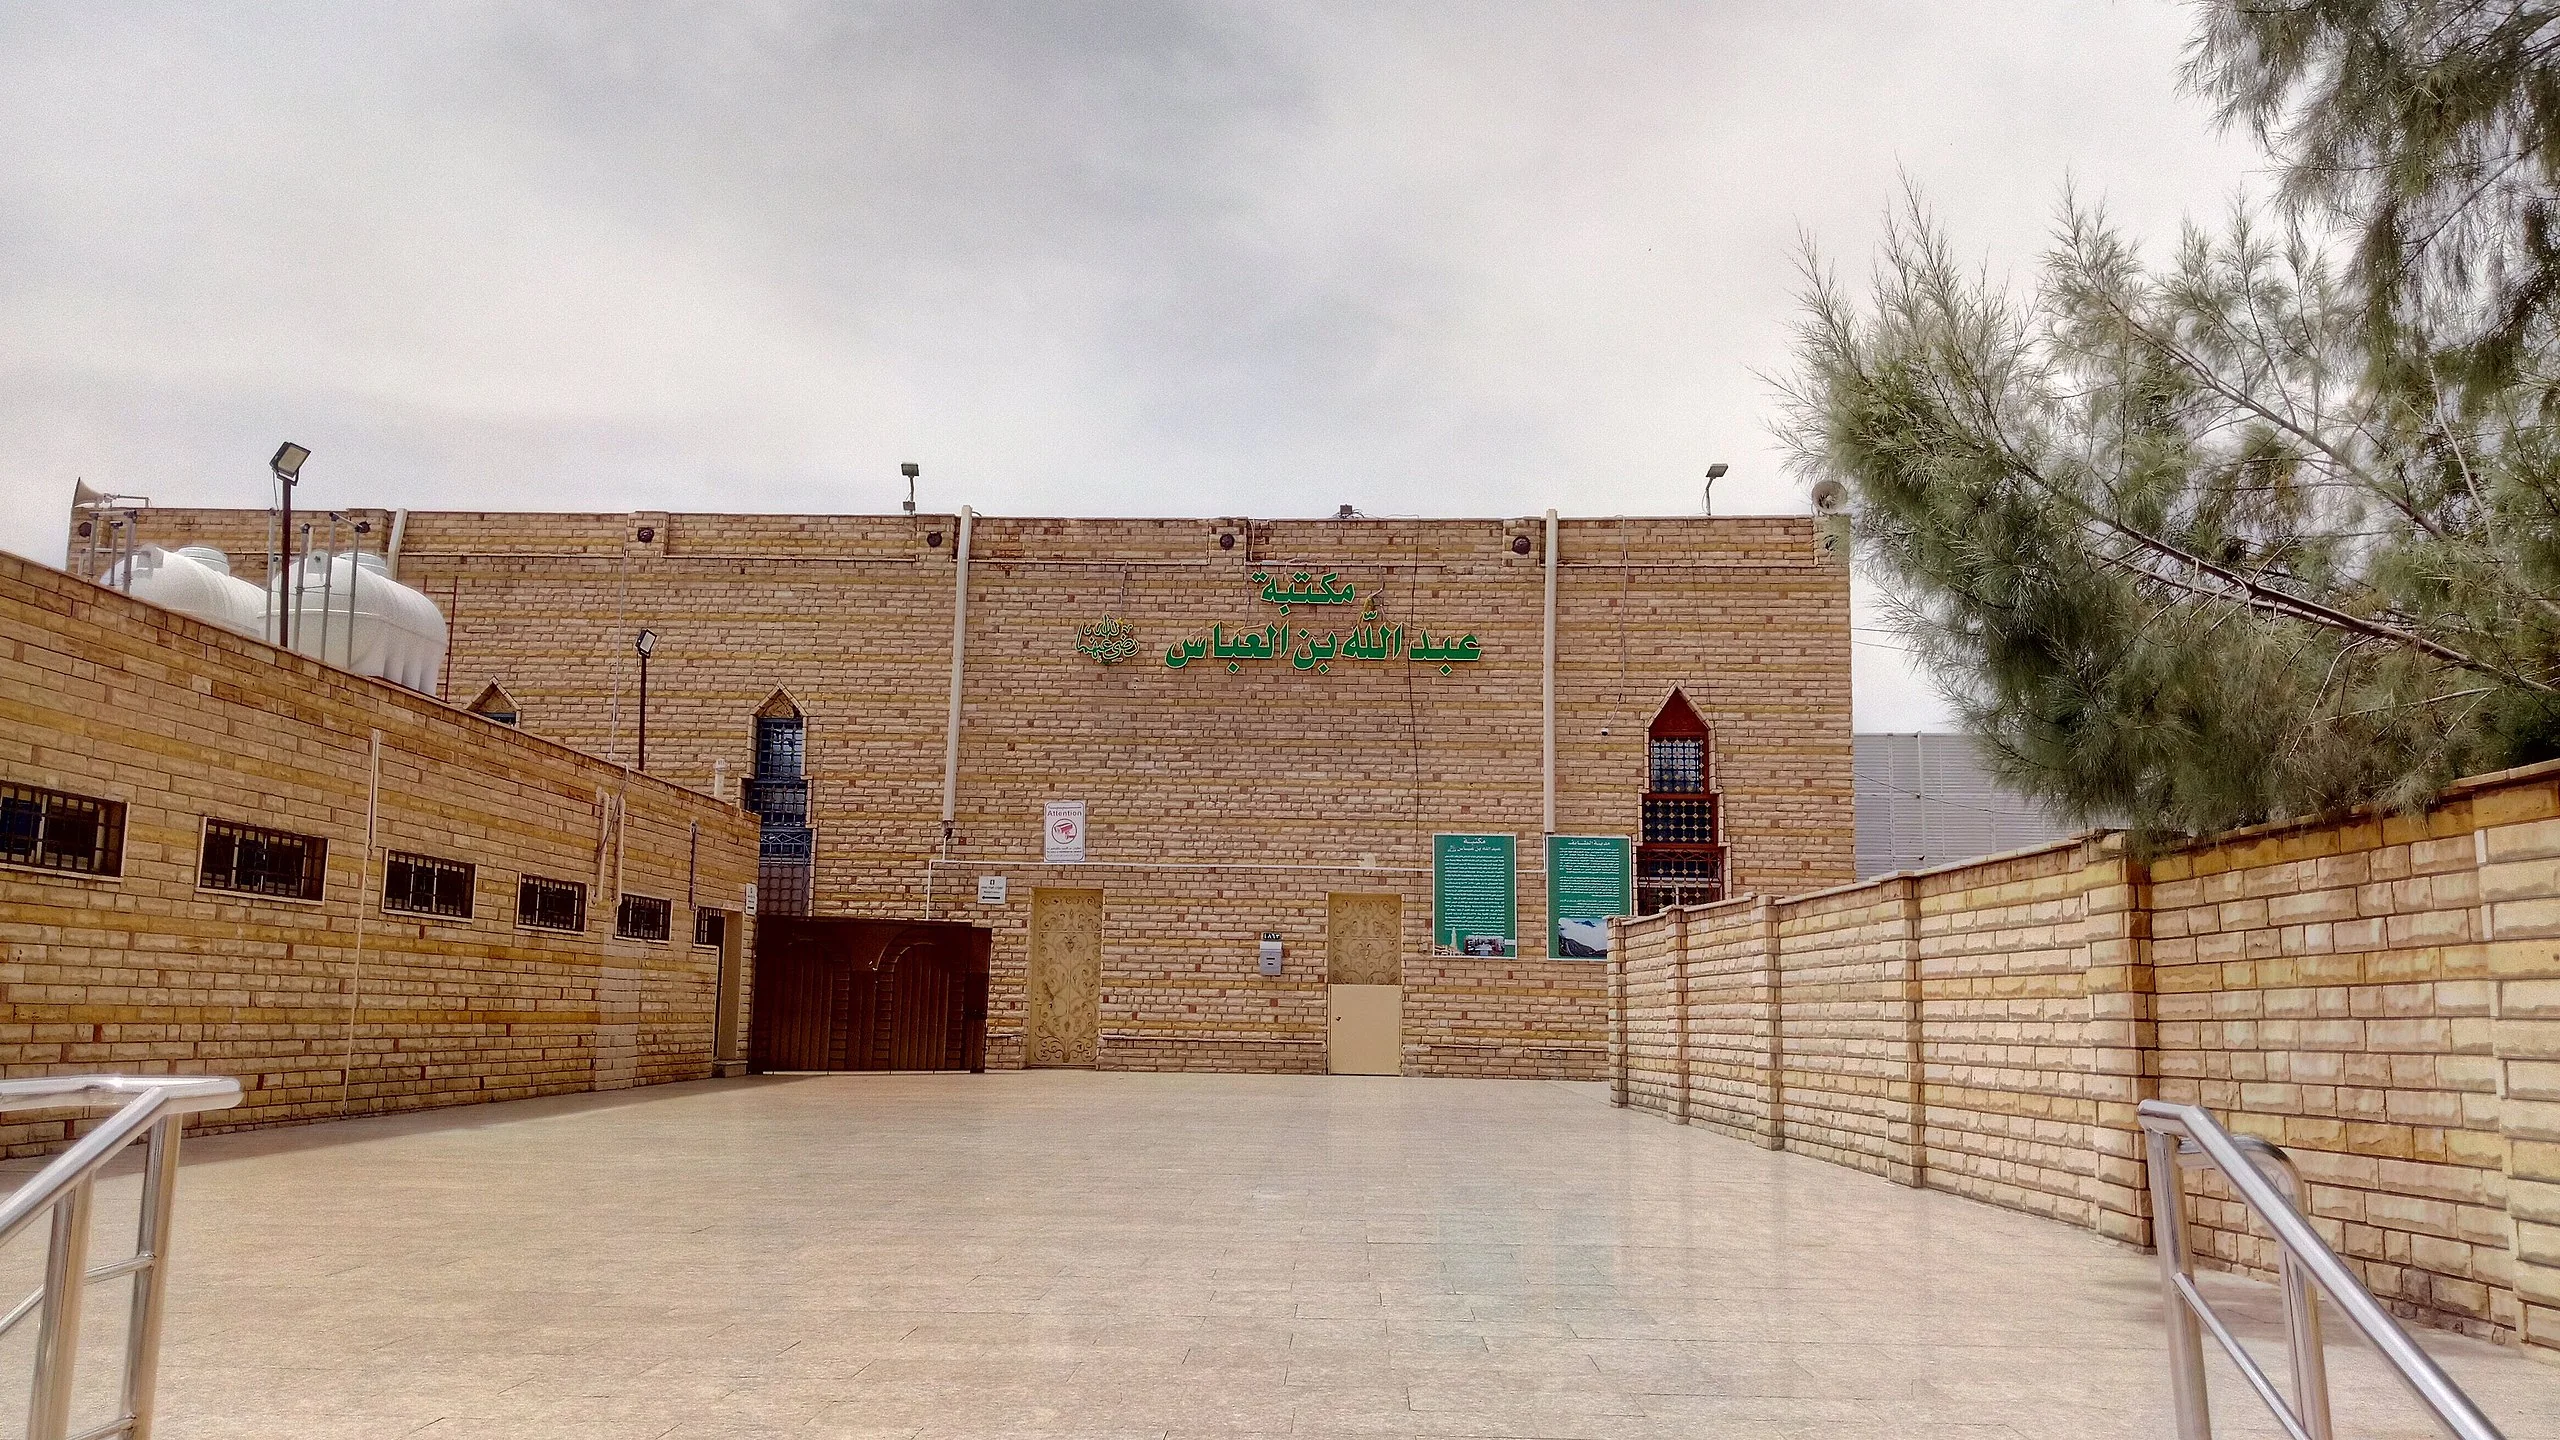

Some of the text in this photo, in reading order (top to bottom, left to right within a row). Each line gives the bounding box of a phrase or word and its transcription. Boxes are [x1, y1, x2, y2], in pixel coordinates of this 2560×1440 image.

[1251, 571, 1355, 617] مكتبة
[1165, 610, 1482, 676] عبد الله بن العباس
